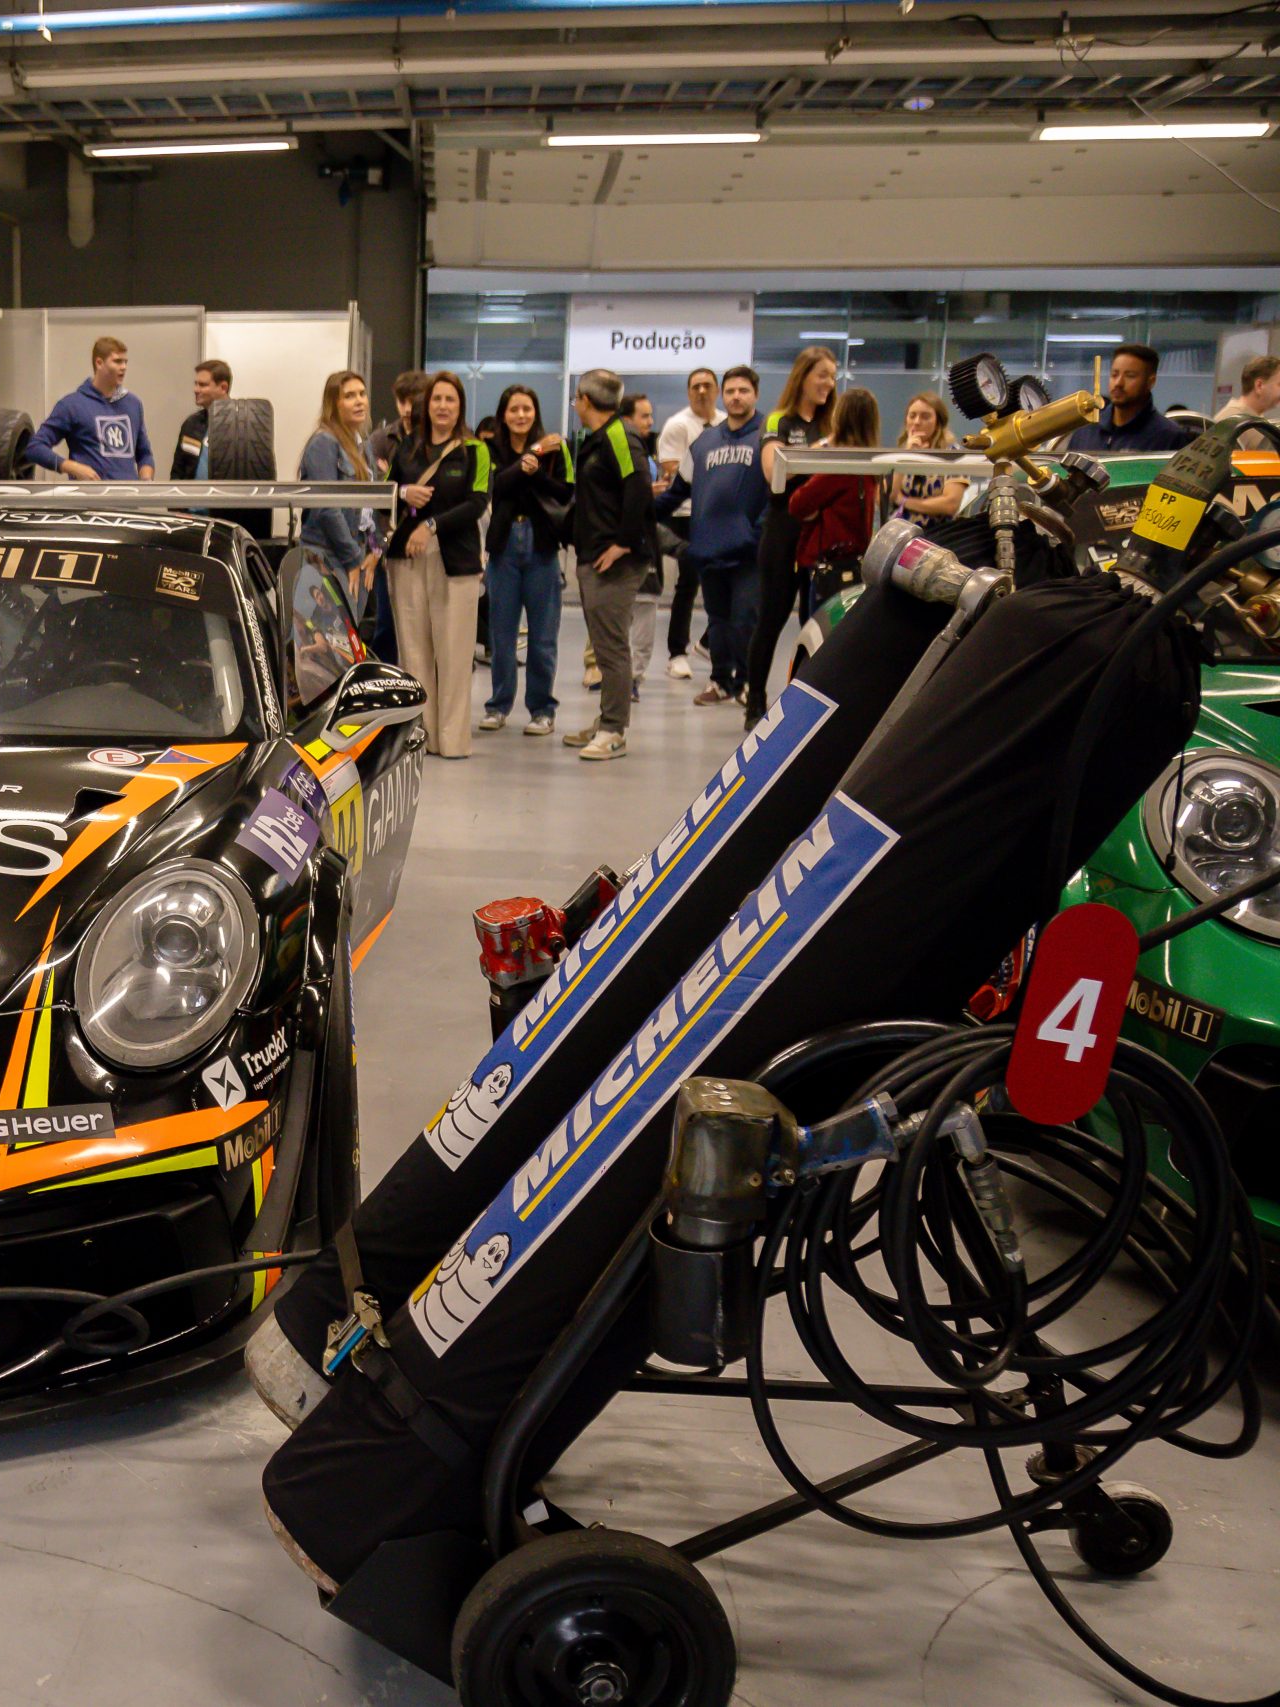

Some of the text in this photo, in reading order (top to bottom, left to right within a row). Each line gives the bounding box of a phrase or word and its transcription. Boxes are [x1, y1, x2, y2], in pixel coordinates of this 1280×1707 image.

[611, 329, 706, 356] Produção
[1160, 492, 1177, 505] PP
[512, 698, 788, 1046] MICHELIN
[513, 813, 838, 1212] MICHELIN
[1036, 977, 1103, 1063] 4
[241, 1026, 289, 1077] TruckX
[223, 1113, 271, 1172] Mobil
